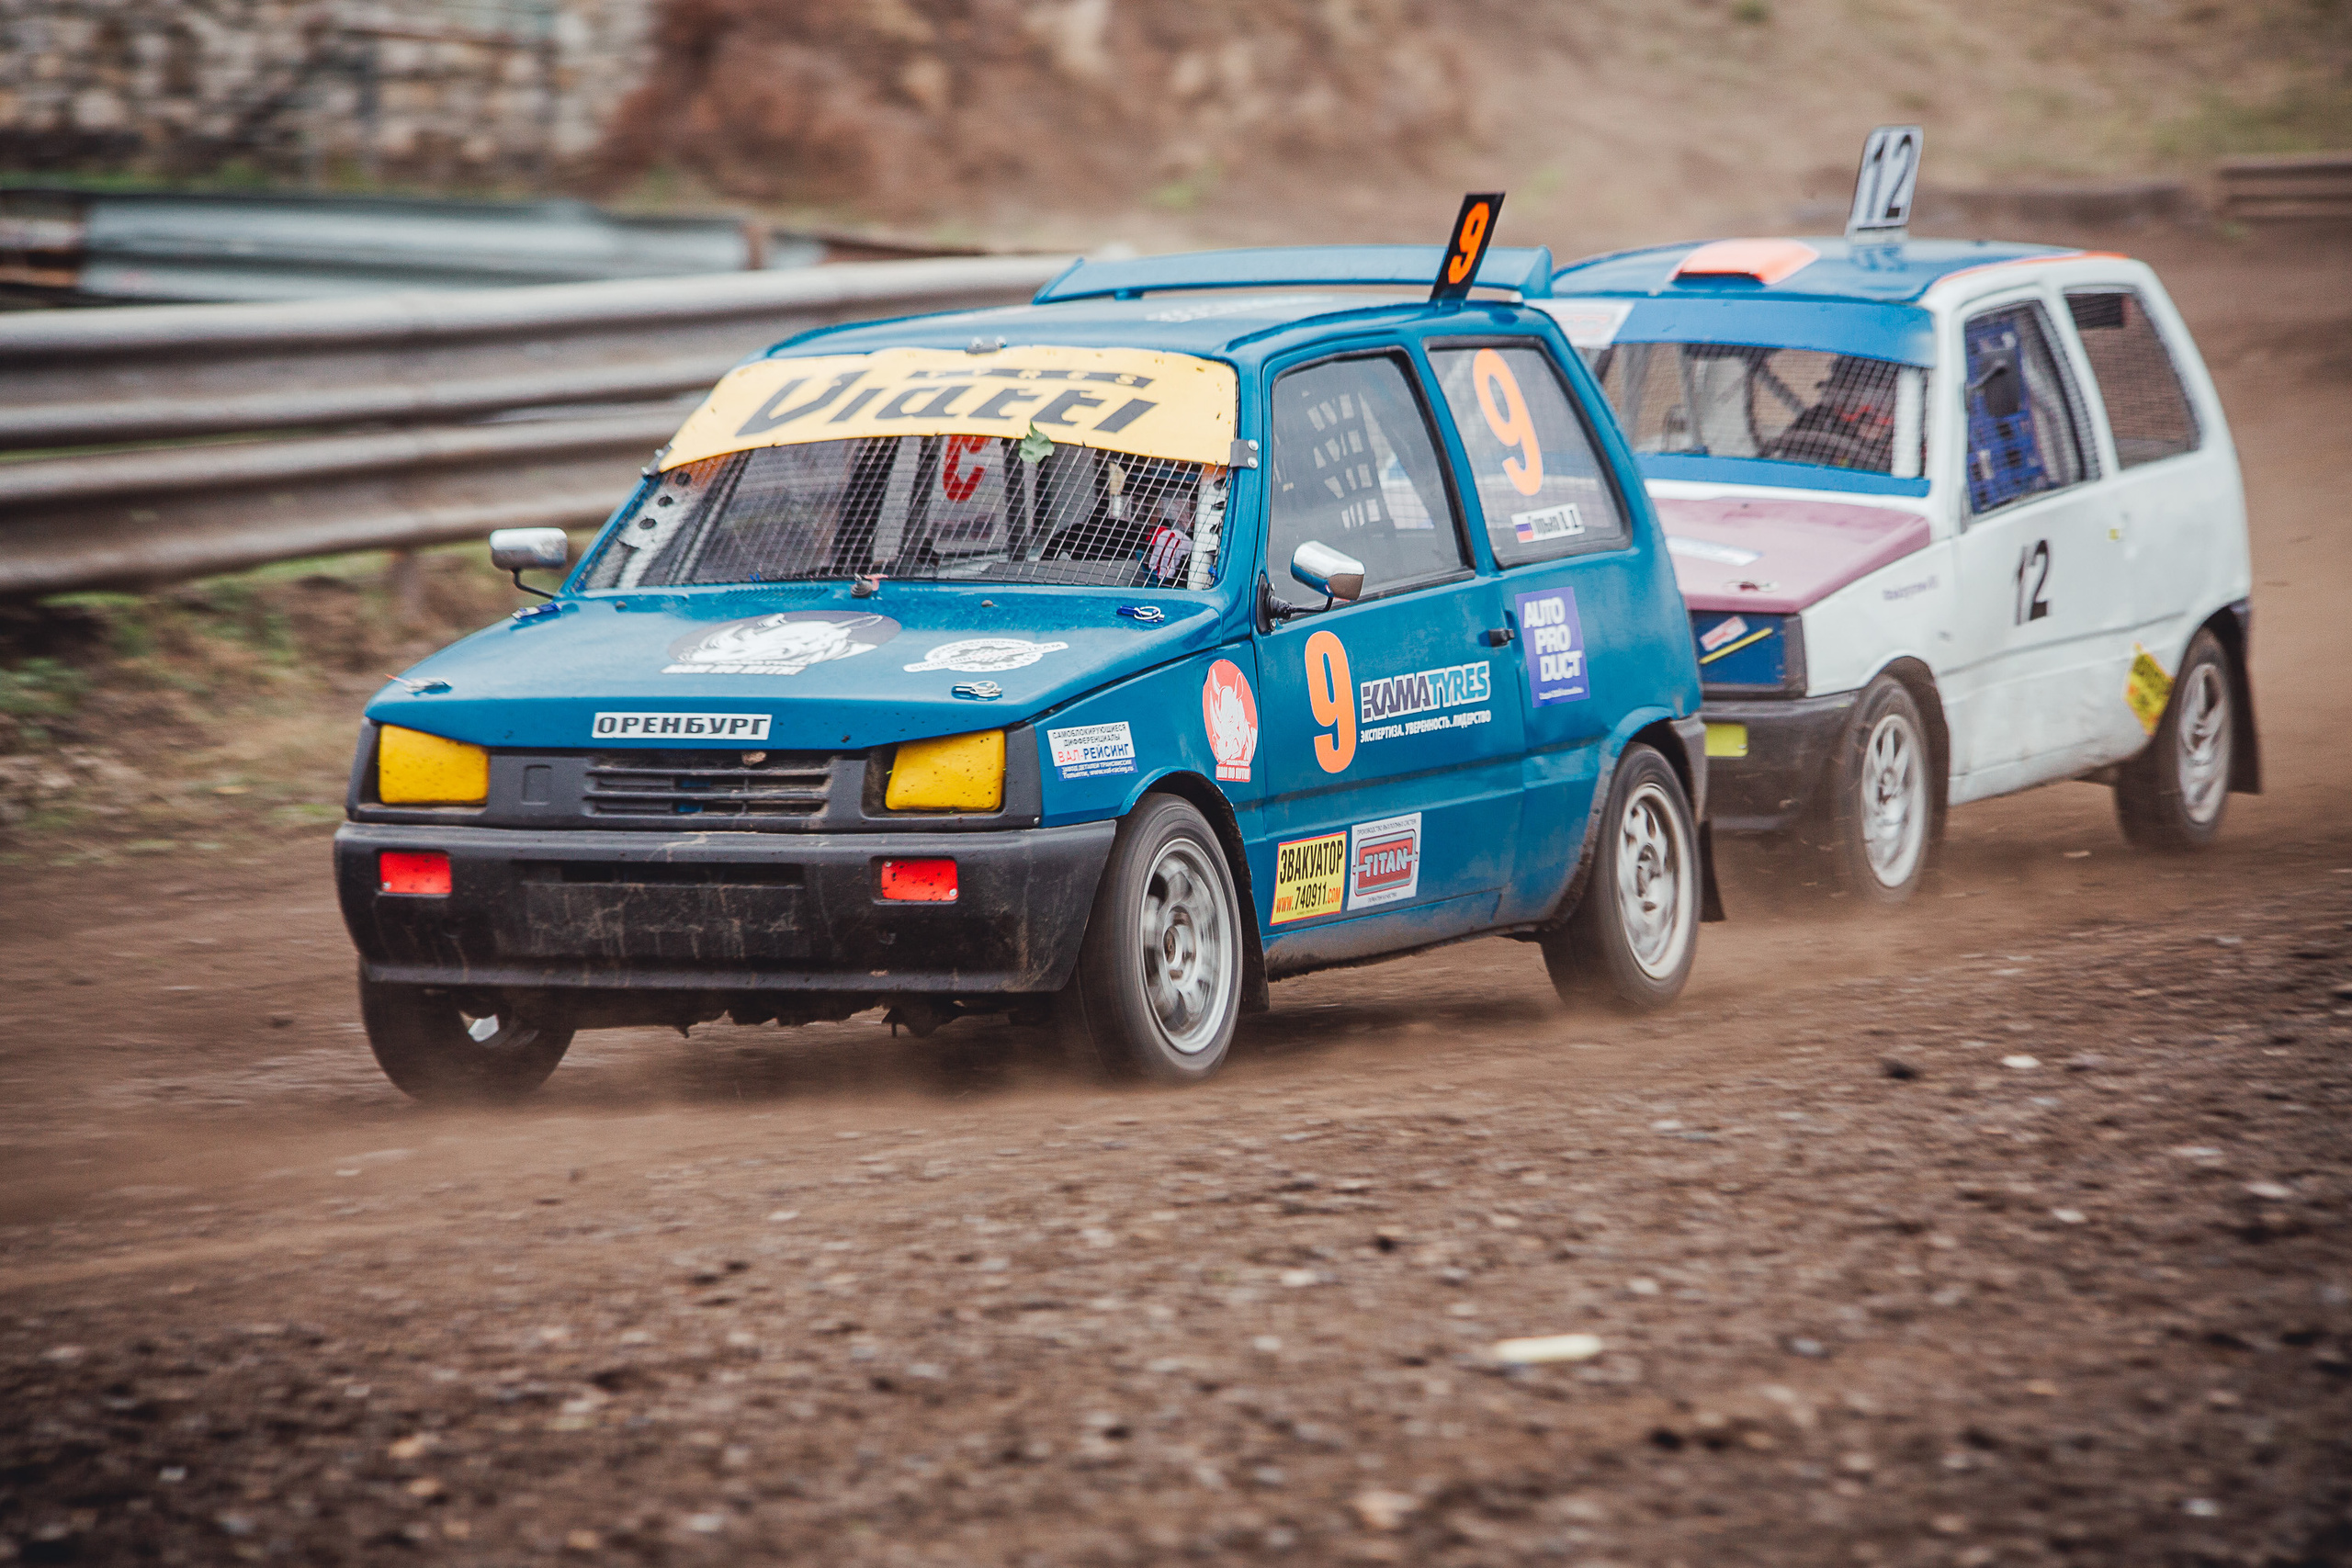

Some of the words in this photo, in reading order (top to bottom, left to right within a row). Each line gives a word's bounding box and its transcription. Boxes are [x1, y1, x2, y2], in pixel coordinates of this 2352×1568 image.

[1858, 130, 1916, 228] 12
[1448, 201, 1490, 284] 9
[1473, 348, 1544, 496] 9
[2014, 538, 2052, 626] 12
[1524, 596, 1566, 628] AUTO
[1028, 643, 1062, 653] TEAM
[1534, 625, 1572, 655] PRO
[1540, 649, 1582, 682] DUCT
[1305, 630, 1356, 773] 9
[596, 715, 768, 737] ОРЕНБУРГ
[1052, 724, 1126, 739] САМОБЛОКИРУЮЩИЕСЯ
[1453, 710, 1491, 728] ЛИДЕРСТВО
[1057, 743, 1129, 762] ВАЛ-РЕЙСИНГ
[1064, 733, 1121, 747] ДИФФЕРЕНЦИАЛЫ
[1280, 840, 1343, 885] ЭВАКУАТОР
[1364, 847, 1408, 878] TITAN
